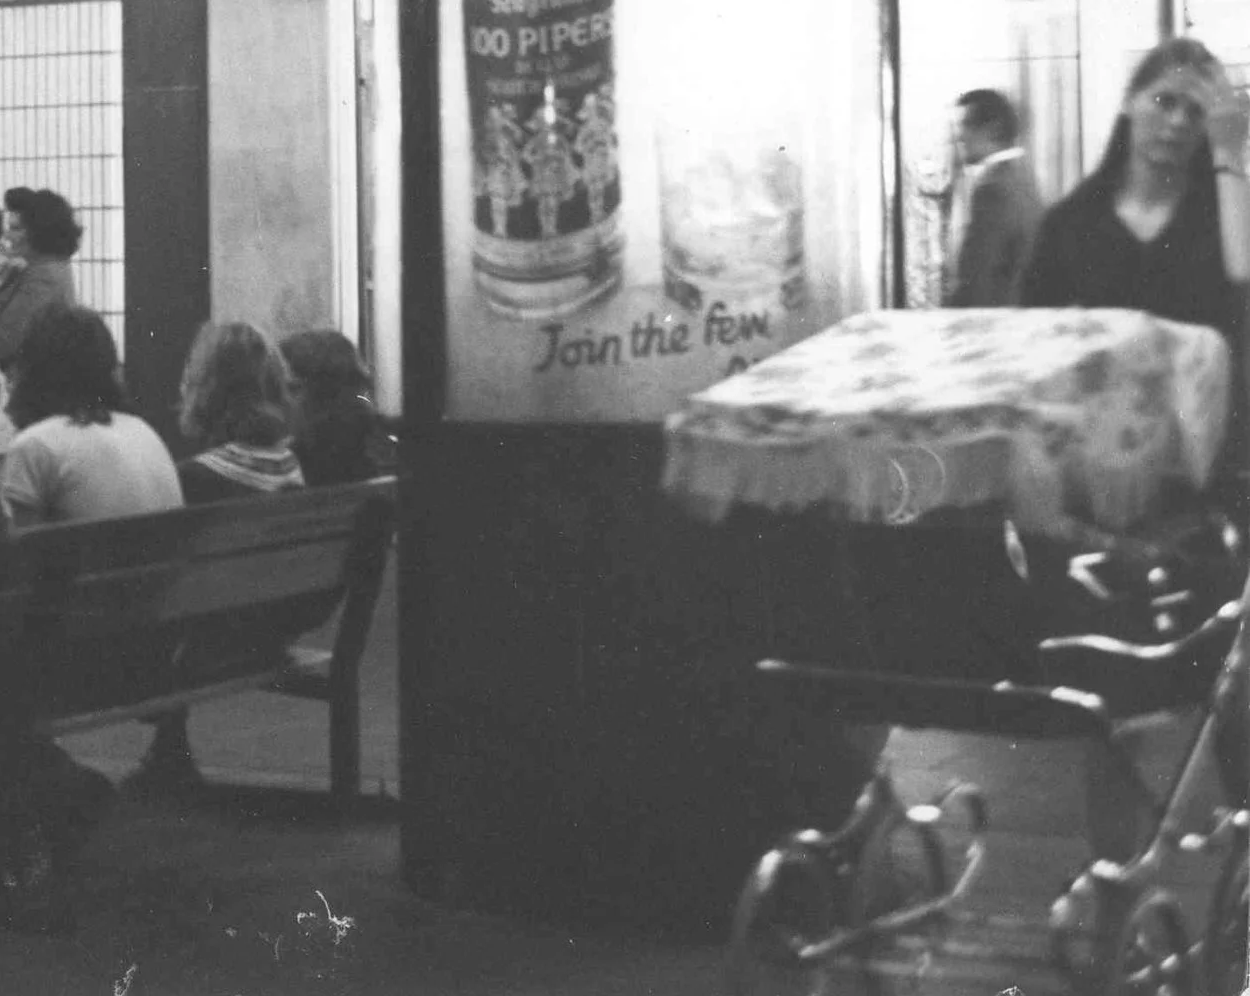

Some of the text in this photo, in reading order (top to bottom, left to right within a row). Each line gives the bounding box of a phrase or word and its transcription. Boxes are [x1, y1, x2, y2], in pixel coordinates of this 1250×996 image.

[532, 300, 772, 375] Join the few
